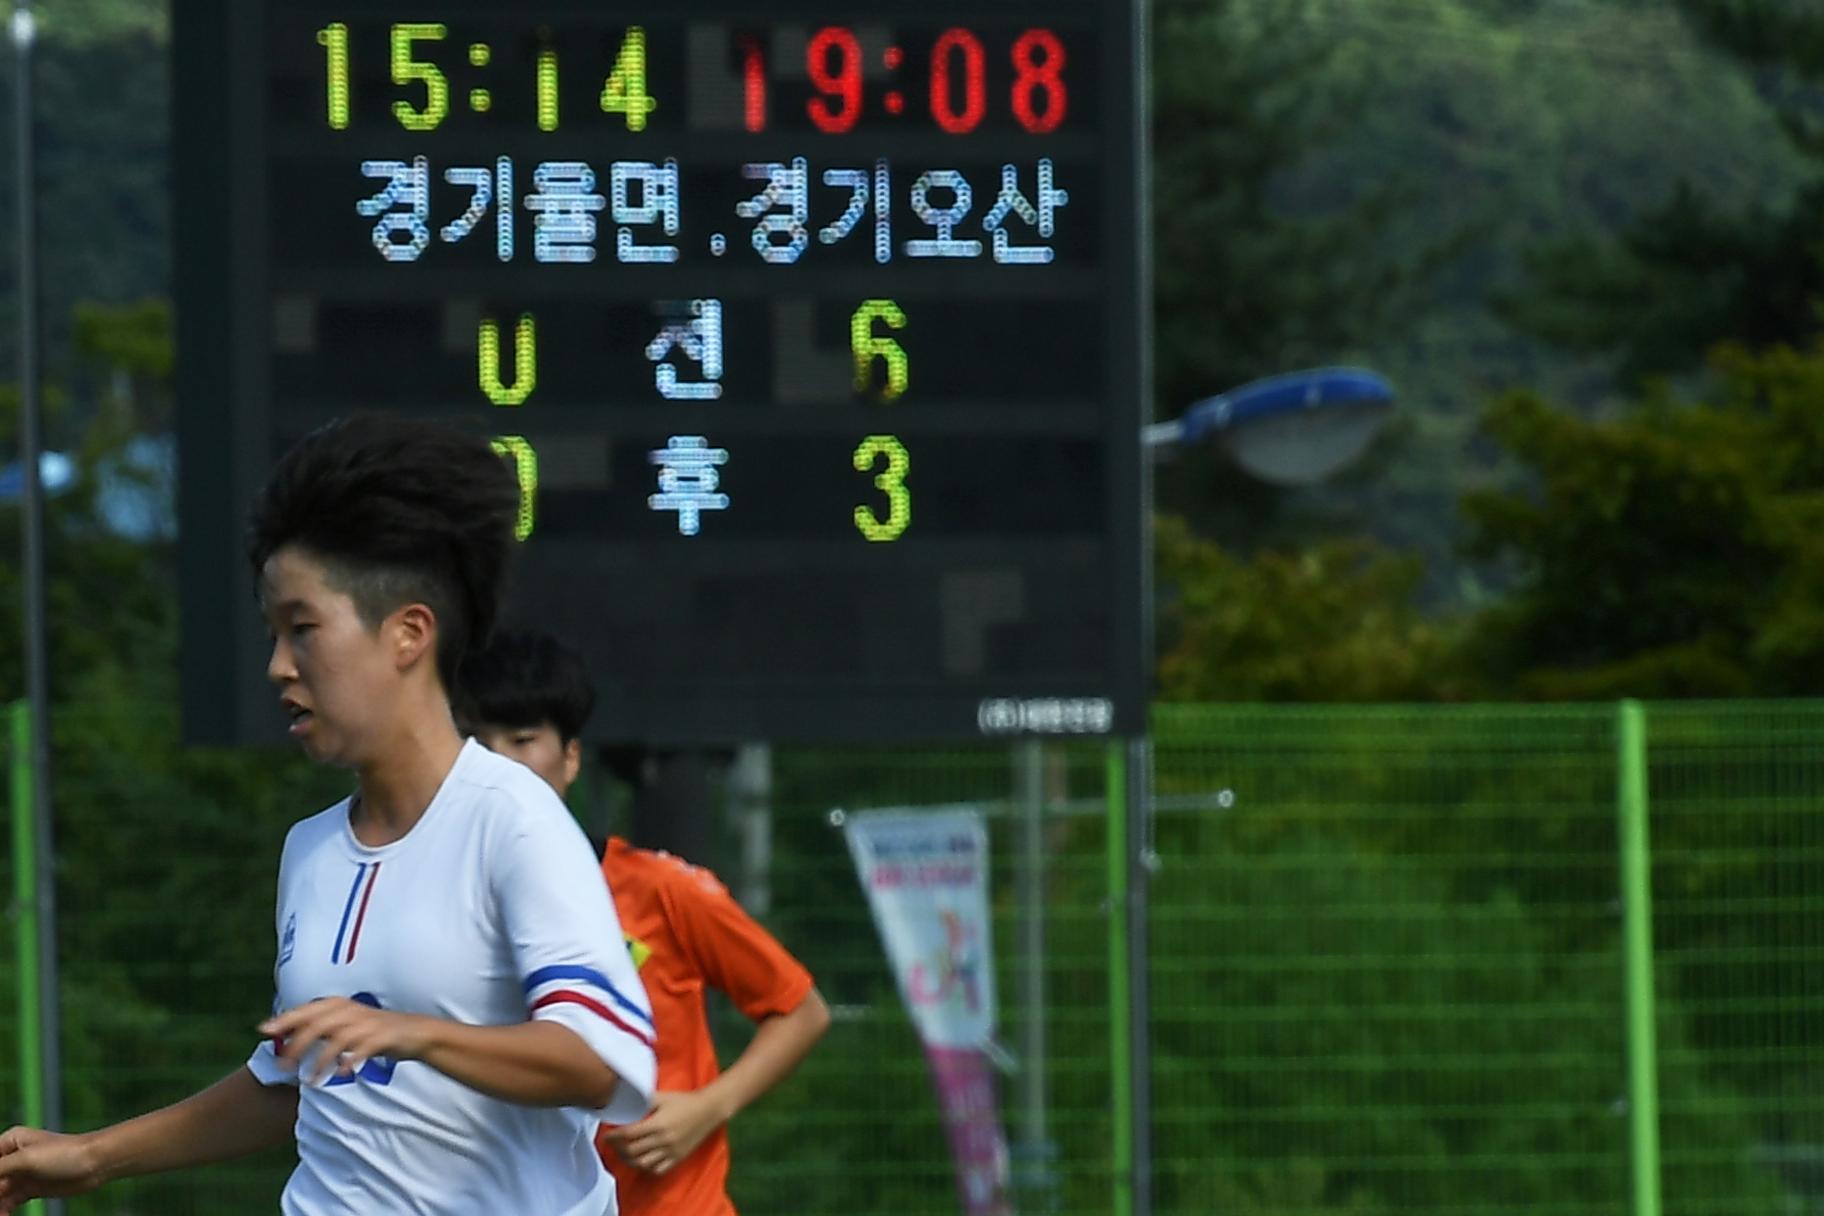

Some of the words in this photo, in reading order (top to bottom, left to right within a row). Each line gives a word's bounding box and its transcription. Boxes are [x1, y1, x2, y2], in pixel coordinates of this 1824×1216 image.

[317, 23, 657, 131] 15:14
[740, 26, 1067, 133] 19:08
[851, 298, 909, 401] 6
[646, 434, 730, 537] 후
[853, 434, 912, 543] 3
